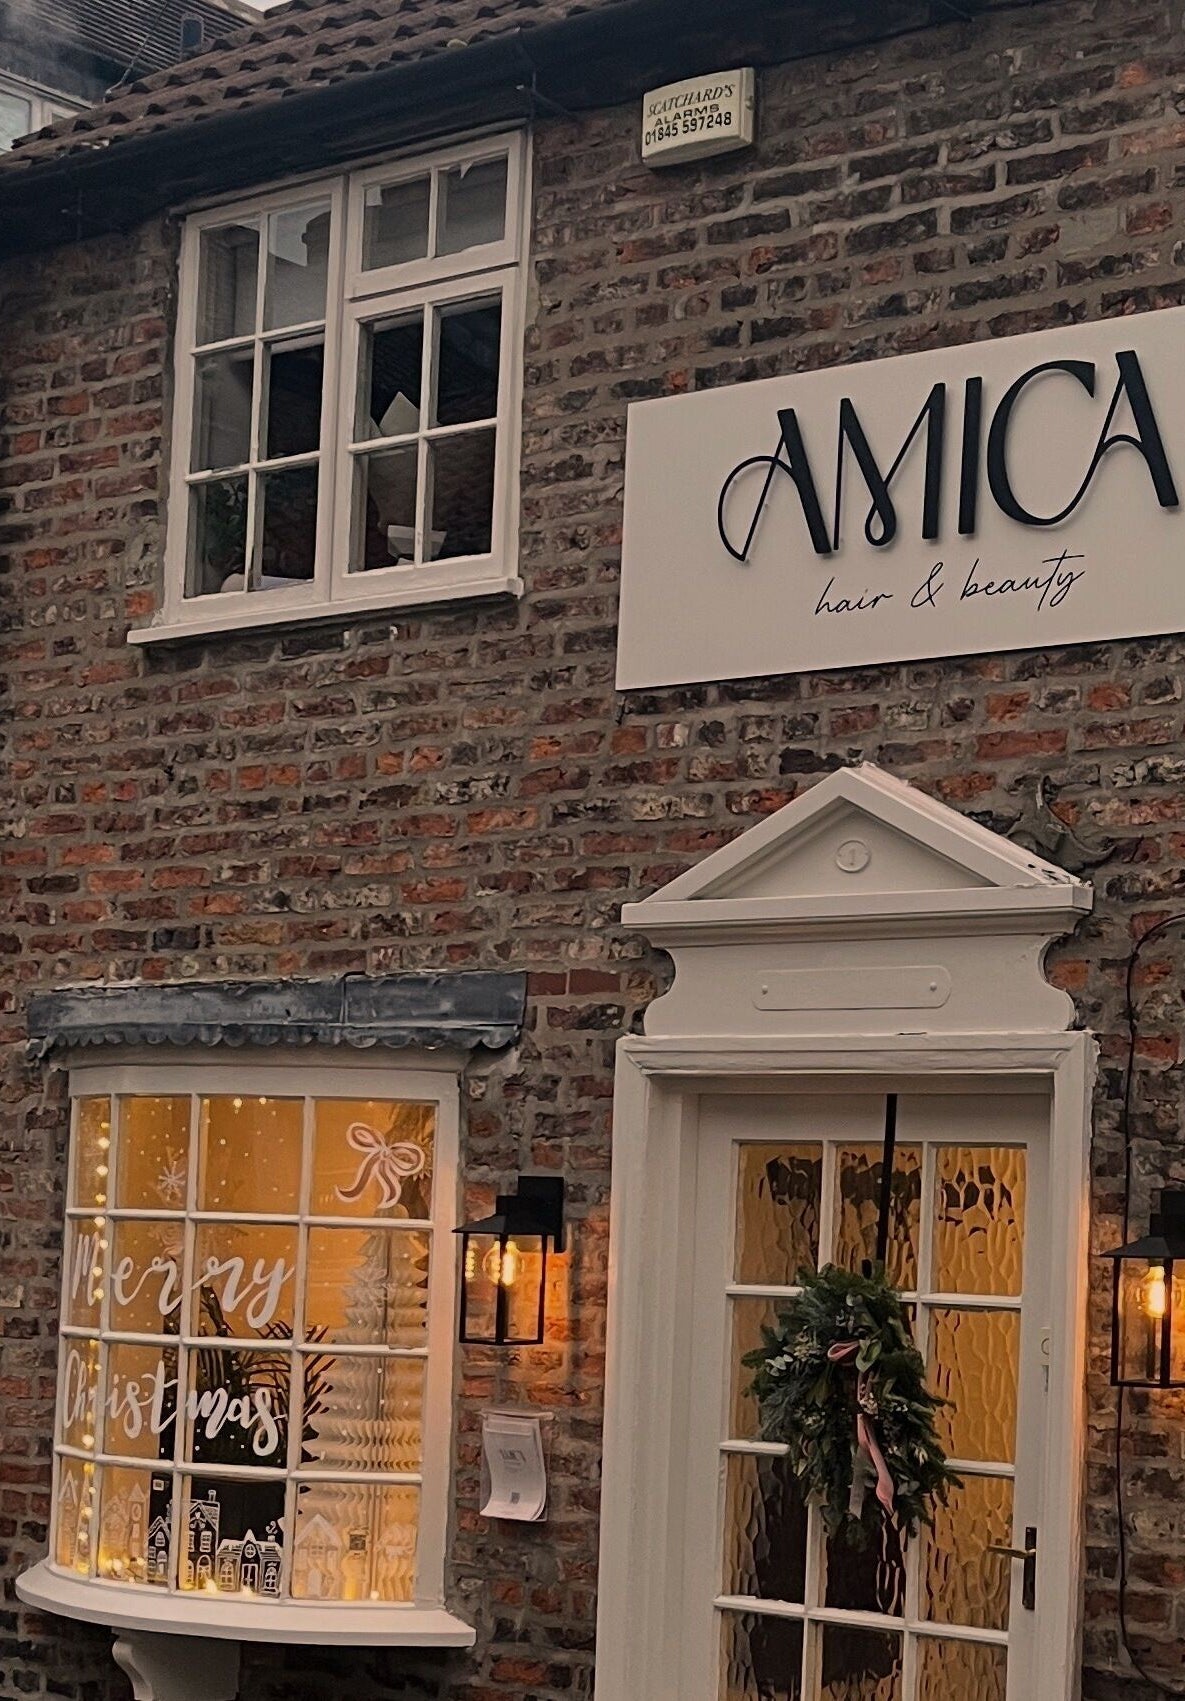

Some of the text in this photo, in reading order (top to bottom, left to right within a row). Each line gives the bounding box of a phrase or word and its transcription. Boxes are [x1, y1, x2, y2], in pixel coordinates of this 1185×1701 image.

[645, 112, 732, 145] 01845 597248
[647, 84, 735, 118] SCATCHARD'S
[655, 104, 720, 127] ALARMS
[718, 350, 1180, 561] AMICA
[815, 549, 1085, 615] hair & beauty
[73, 1231, 295, 1329] Merry
[64, 1349, 288, 1457] Christmas
